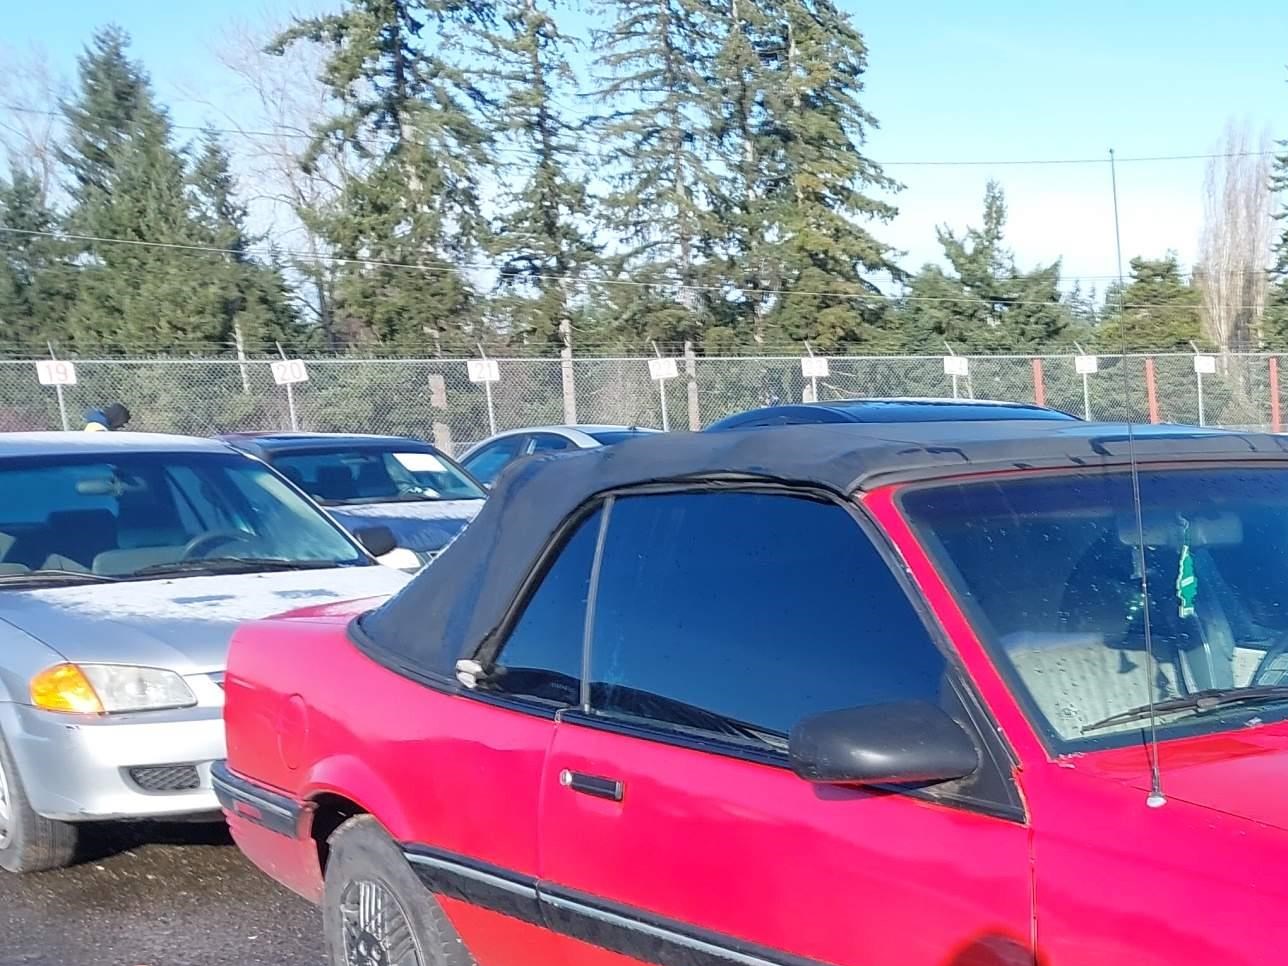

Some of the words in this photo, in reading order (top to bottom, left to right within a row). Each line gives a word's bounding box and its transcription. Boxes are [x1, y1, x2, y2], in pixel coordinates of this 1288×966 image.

[46, 363, 69, 382] 19
[276, 361, 302, 382] 20
[475, 362, 493, 380] 21
